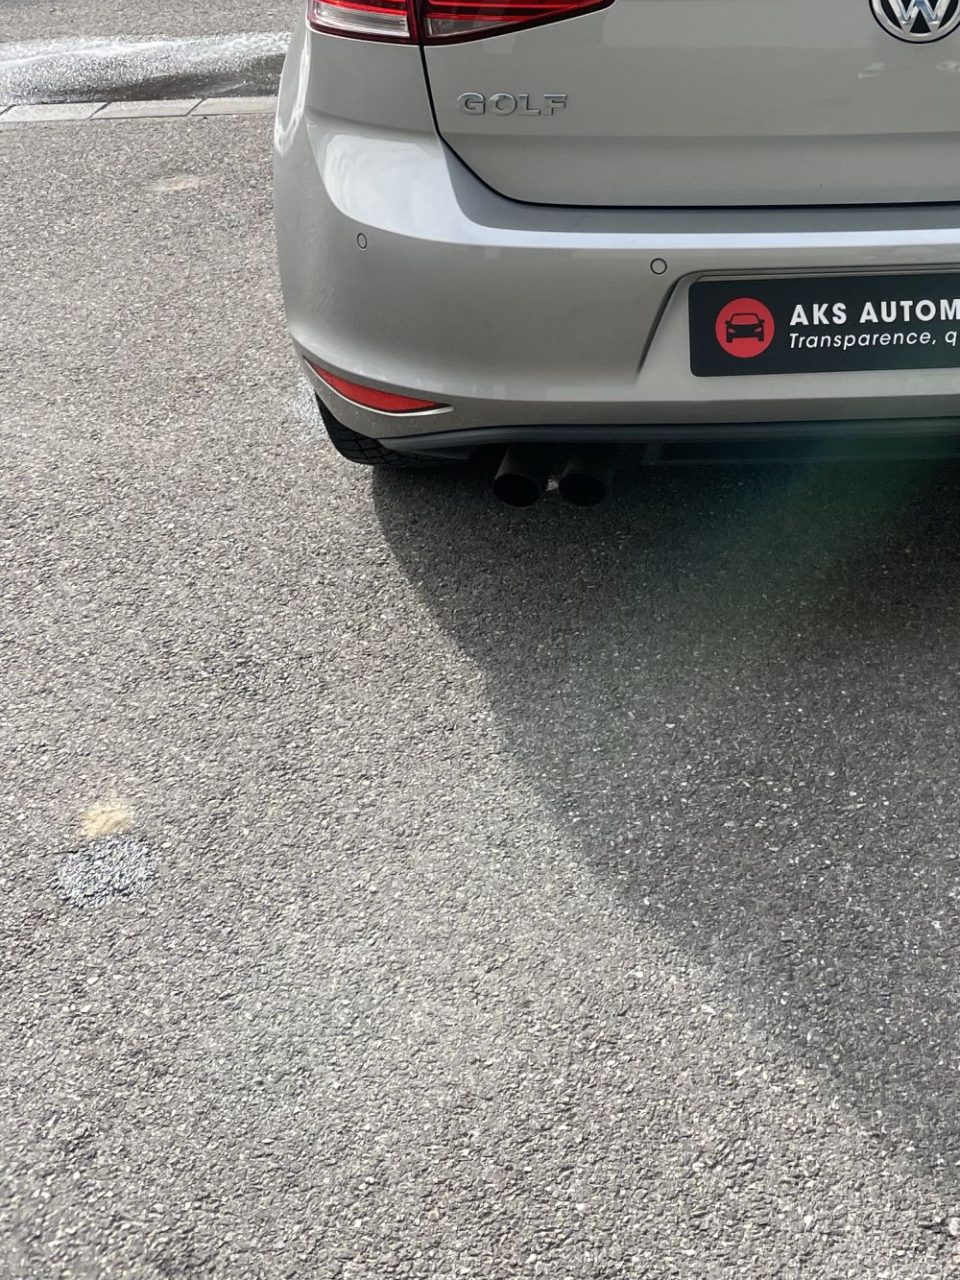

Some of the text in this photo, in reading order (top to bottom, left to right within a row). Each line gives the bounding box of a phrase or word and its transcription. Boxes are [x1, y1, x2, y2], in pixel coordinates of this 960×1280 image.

[457, 92, 568, 116] GOLF
[789, 303, 848, 326] AKS
[789, 330, 937, 350] Transparence,
